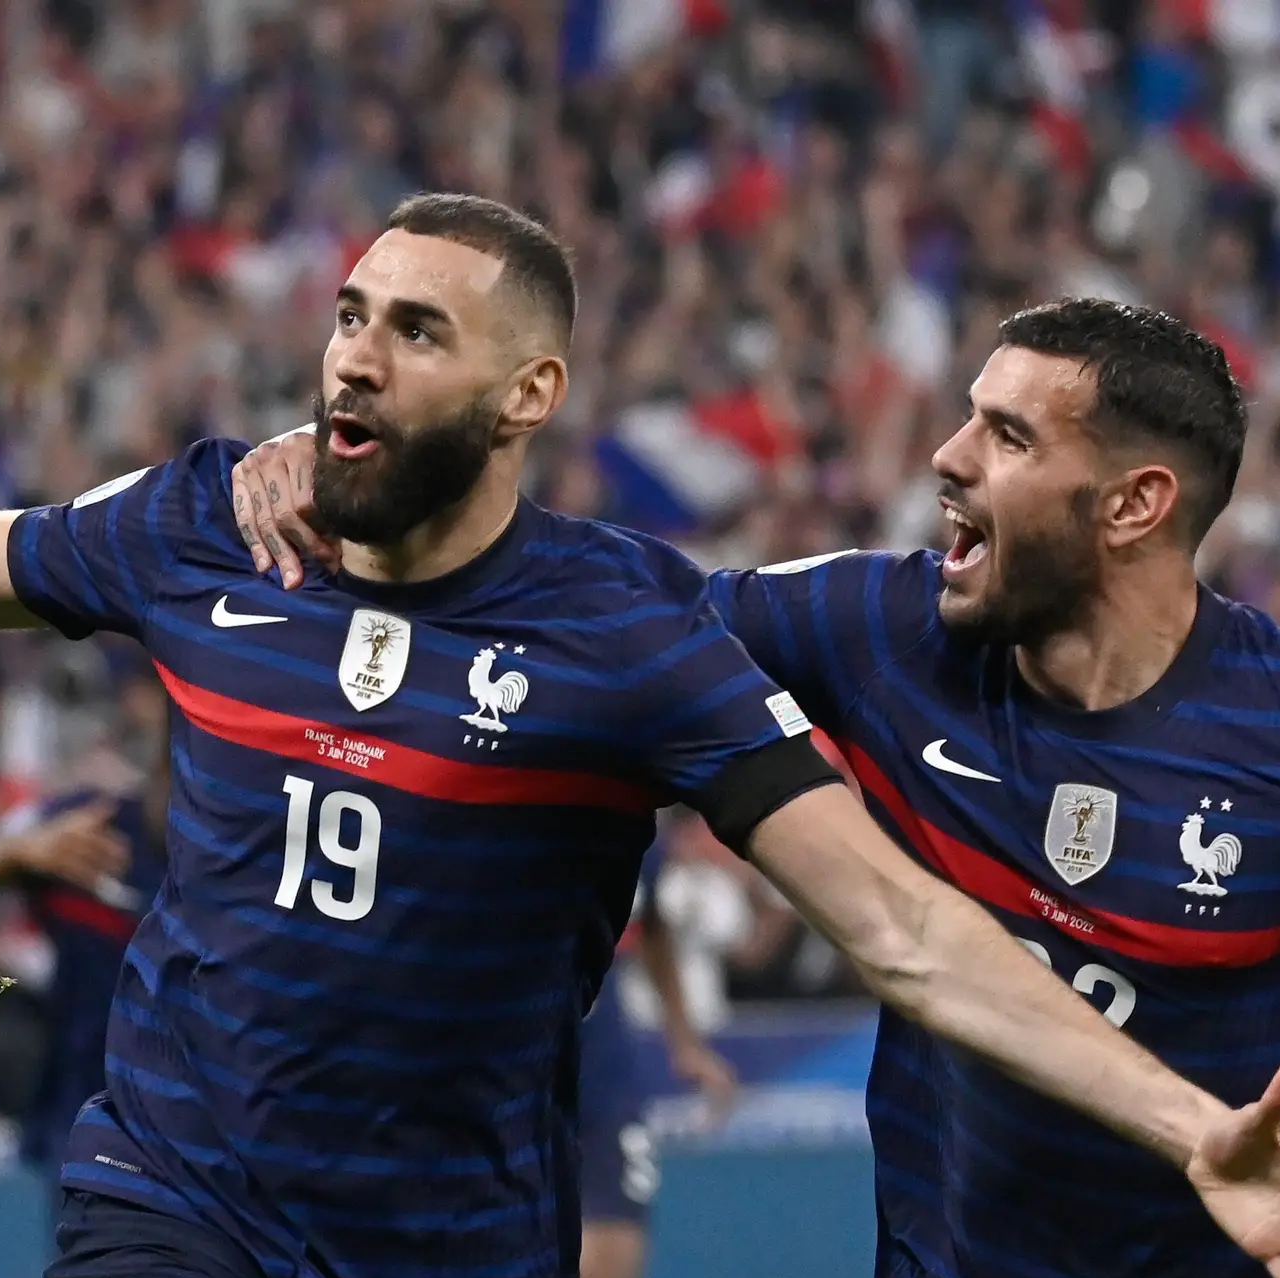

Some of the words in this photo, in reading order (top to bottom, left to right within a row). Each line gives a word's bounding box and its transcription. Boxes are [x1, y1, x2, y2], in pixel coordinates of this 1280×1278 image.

[355, 672, 382, 688] FIFA
[305, 728, 335, 746] FRANCE
[343, 737, 386, 761] DANEMARK
[317, 743, 326, 756] 3
[327, 747, 345, 760] JUIN
[345, 751, 370, 769] 2022
[273, 774, 382, 921] 19
[1063, 847, 1091, 861] FIFA
[1041, 905, 1050, 917] 3
[1050, 909, 1069, 924] JUIN
